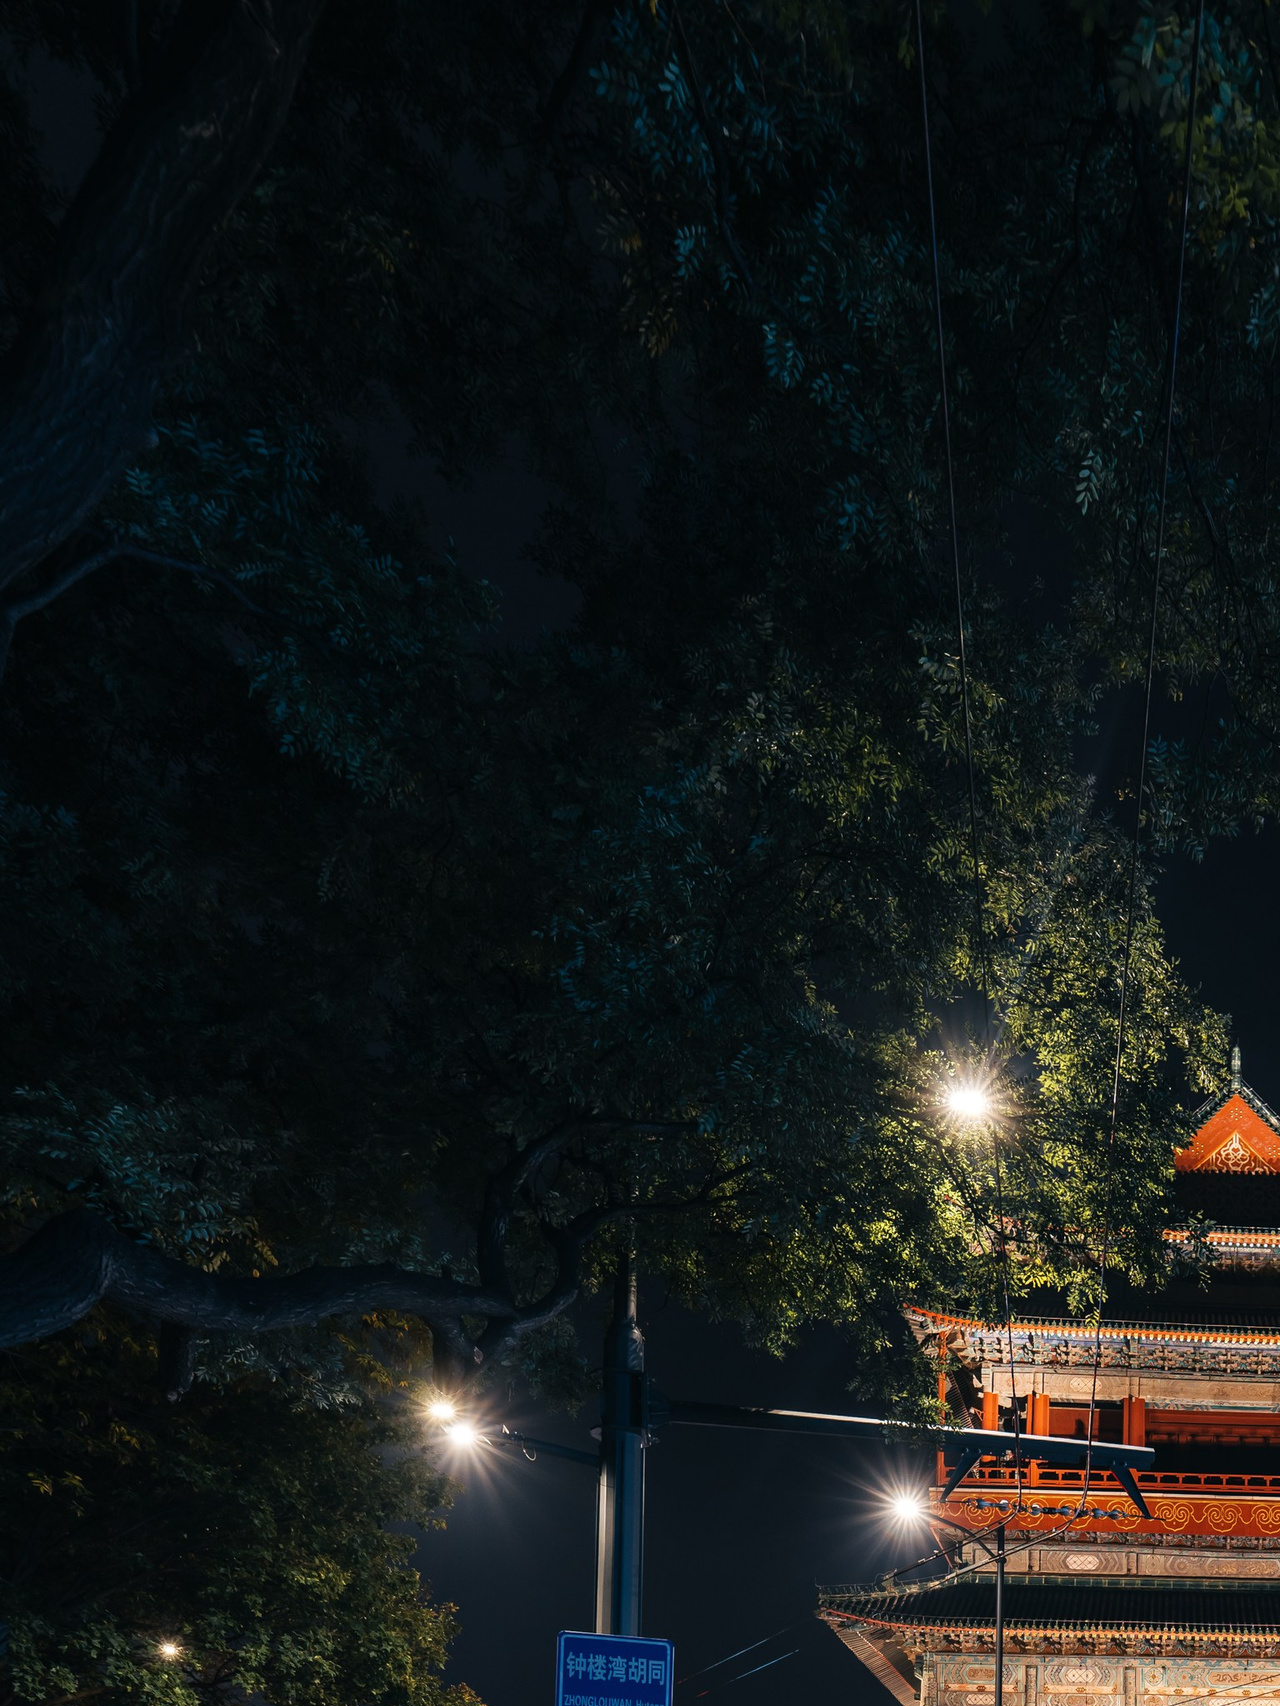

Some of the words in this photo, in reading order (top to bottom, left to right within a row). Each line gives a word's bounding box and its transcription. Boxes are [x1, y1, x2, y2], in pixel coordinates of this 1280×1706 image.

[566, 1652, 665, 1685] 钟楼湾胡同
